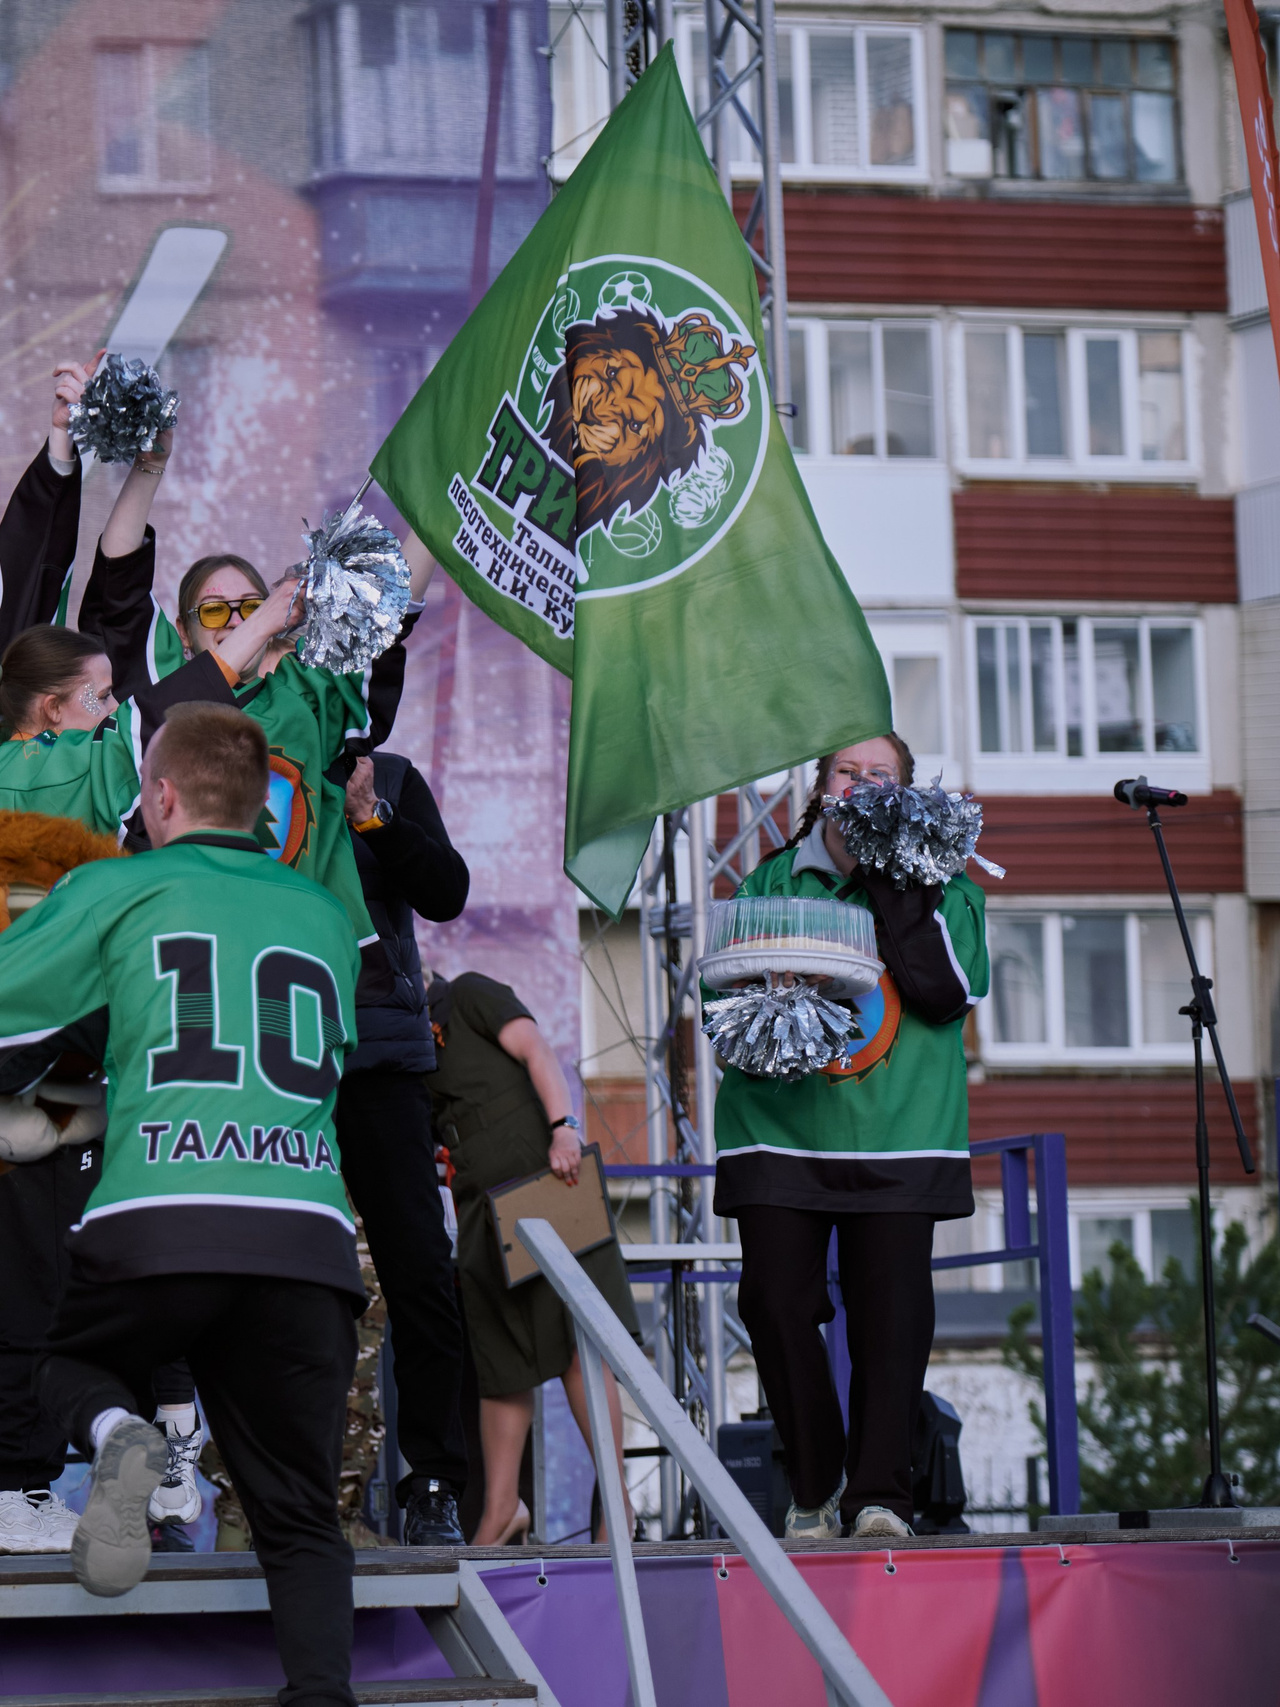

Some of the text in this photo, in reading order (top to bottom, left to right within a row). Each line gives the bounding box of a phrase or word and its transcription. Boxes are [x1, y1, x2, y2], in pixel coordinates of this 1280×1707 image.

[456, 527, 480, 568] им.
[543, 598, 575, 635] Ку
[147, 931, 348, 1105] 10
[139, 1119, 339, 1174] ТАЛИЦА
